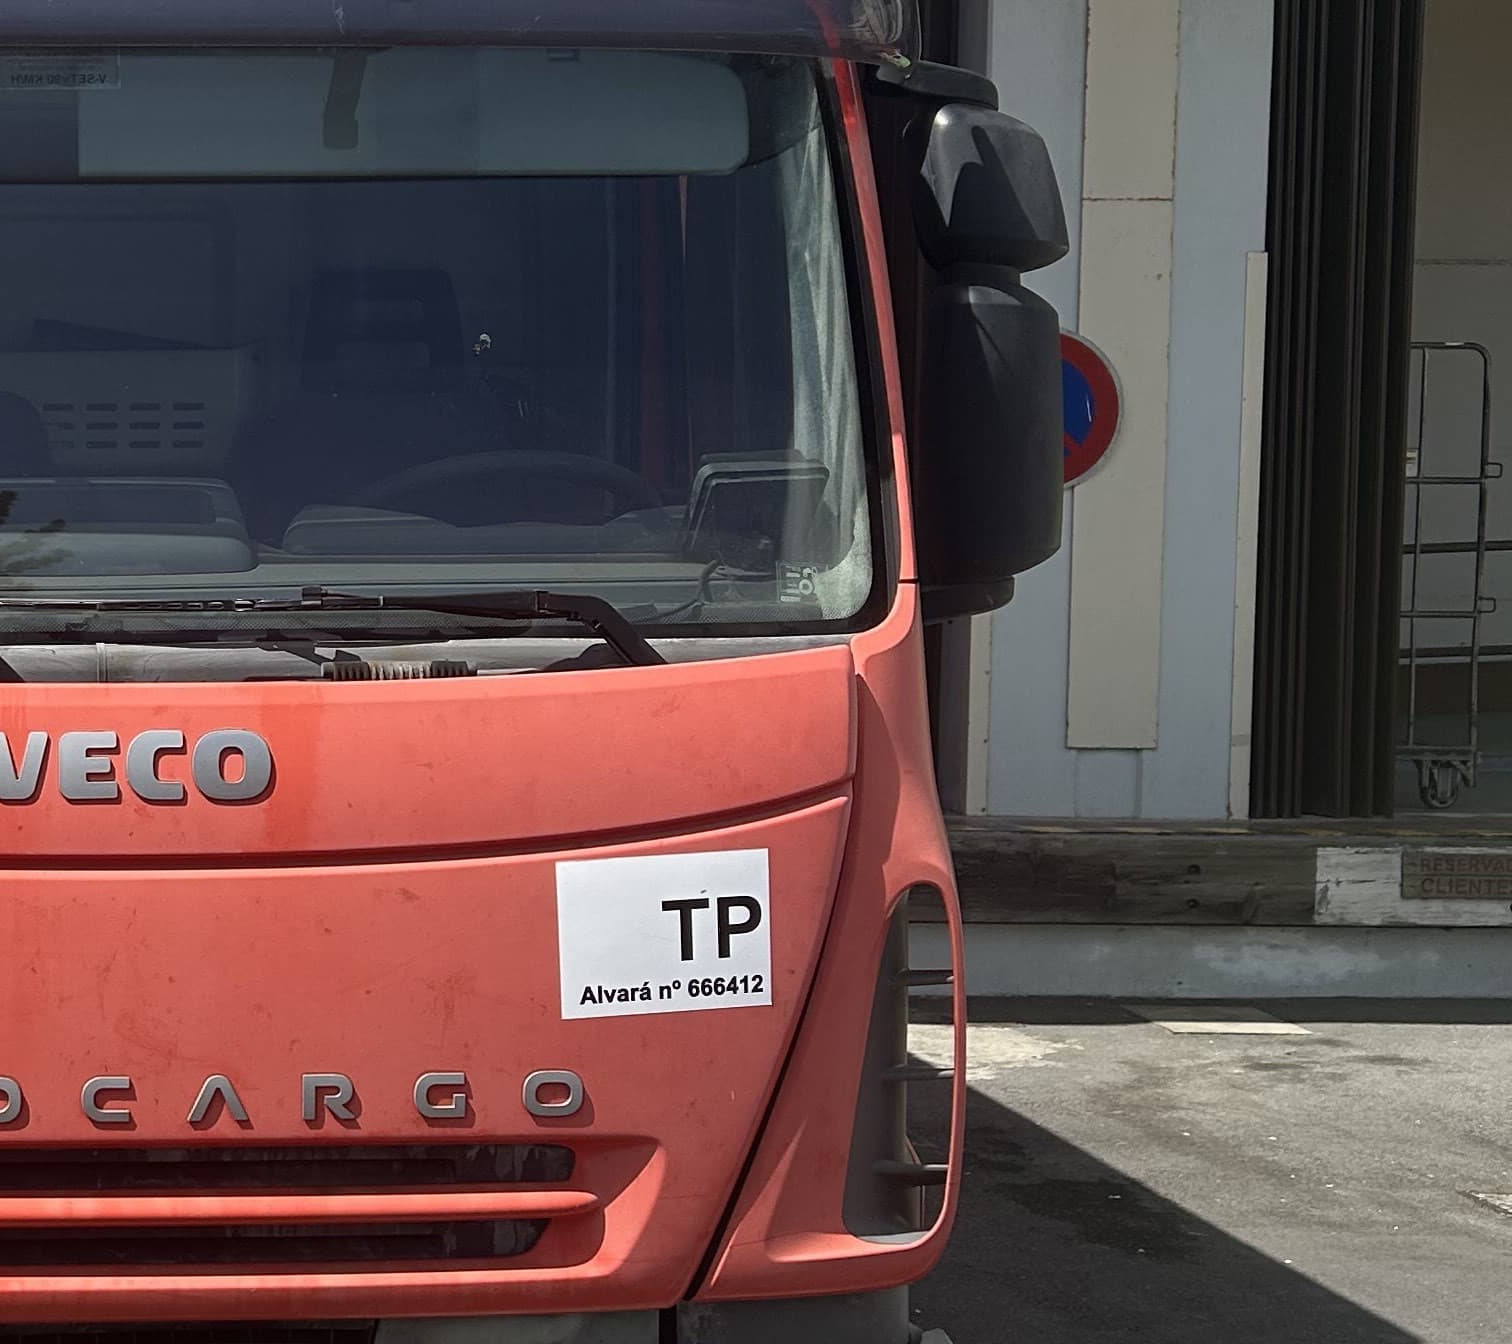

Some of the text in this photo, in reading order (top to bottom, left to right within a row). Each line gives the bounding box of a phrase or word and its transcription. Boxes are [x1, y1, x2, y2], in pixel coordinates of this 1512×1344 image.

[1422, 878, 1512, 895] CLIENTE
[662, 895, 762, 961] TP
[580, 982, 652, 1006] Alvará
[688, 974, 764, 997] 666412
